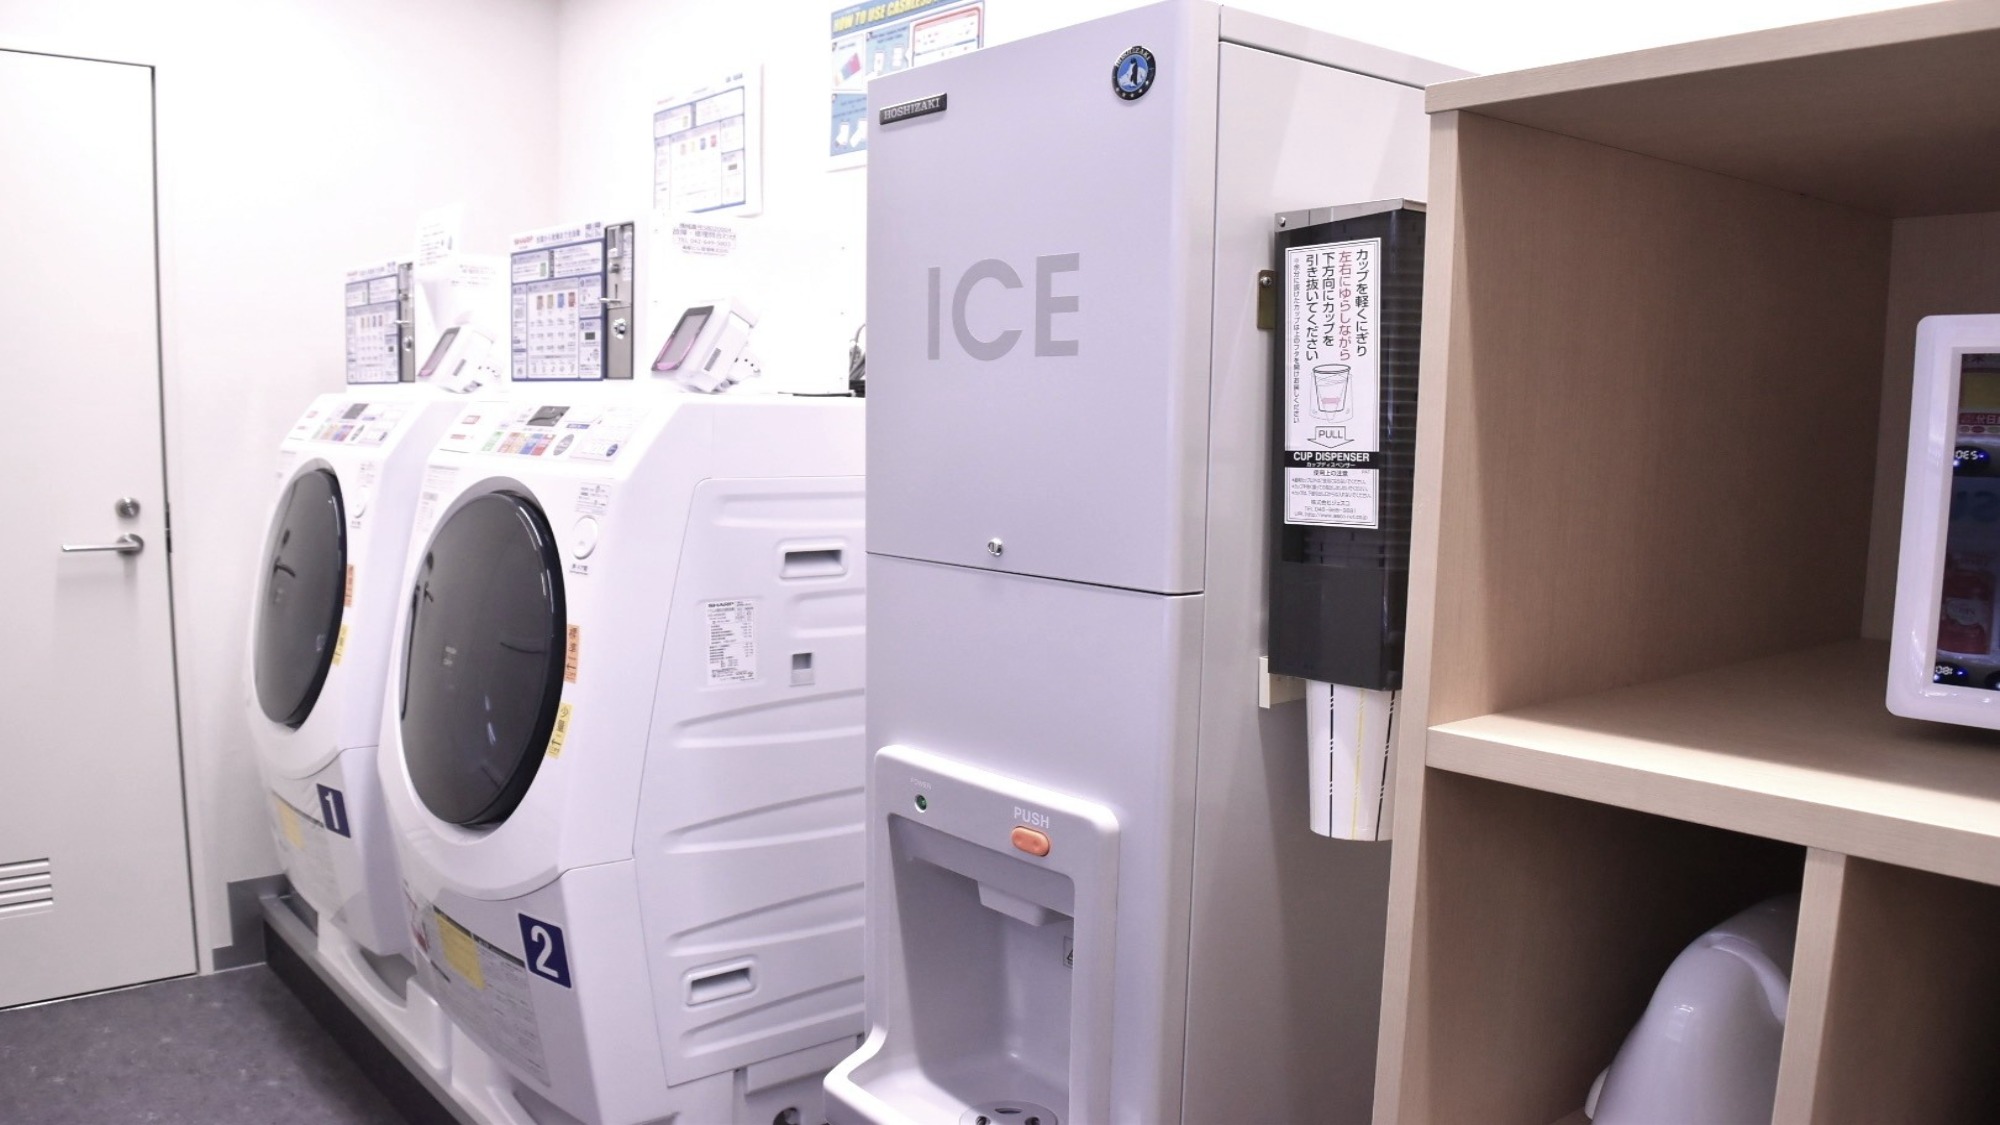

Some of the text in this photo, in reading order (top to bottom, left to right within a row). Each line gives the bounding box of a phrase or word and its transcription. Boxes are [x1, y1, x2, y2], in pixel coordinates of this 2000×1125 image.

[867, 4, 886, 23] USE
[884, 98, 941, 120] HOSHIZAKI
[928, 253, 1080, 361] ICE
[1306, 254, 1319, 361] 引き抜いてください
[1322, 252, 1335, 347] 下方向にカップを
[1339, 250, 1352, 361] 左右にゆらしながら
[1355, 249, 1369, 357] カップを軽くにぎり
[1293, 452, 1370, 462] CUP DISPENSER
[1318, 430, 1343, 439] PULL
[324, 791, 340, 830] 1
[1014, 806, 1049, 829] PUSH
[530, 924, 559, 979] 2
